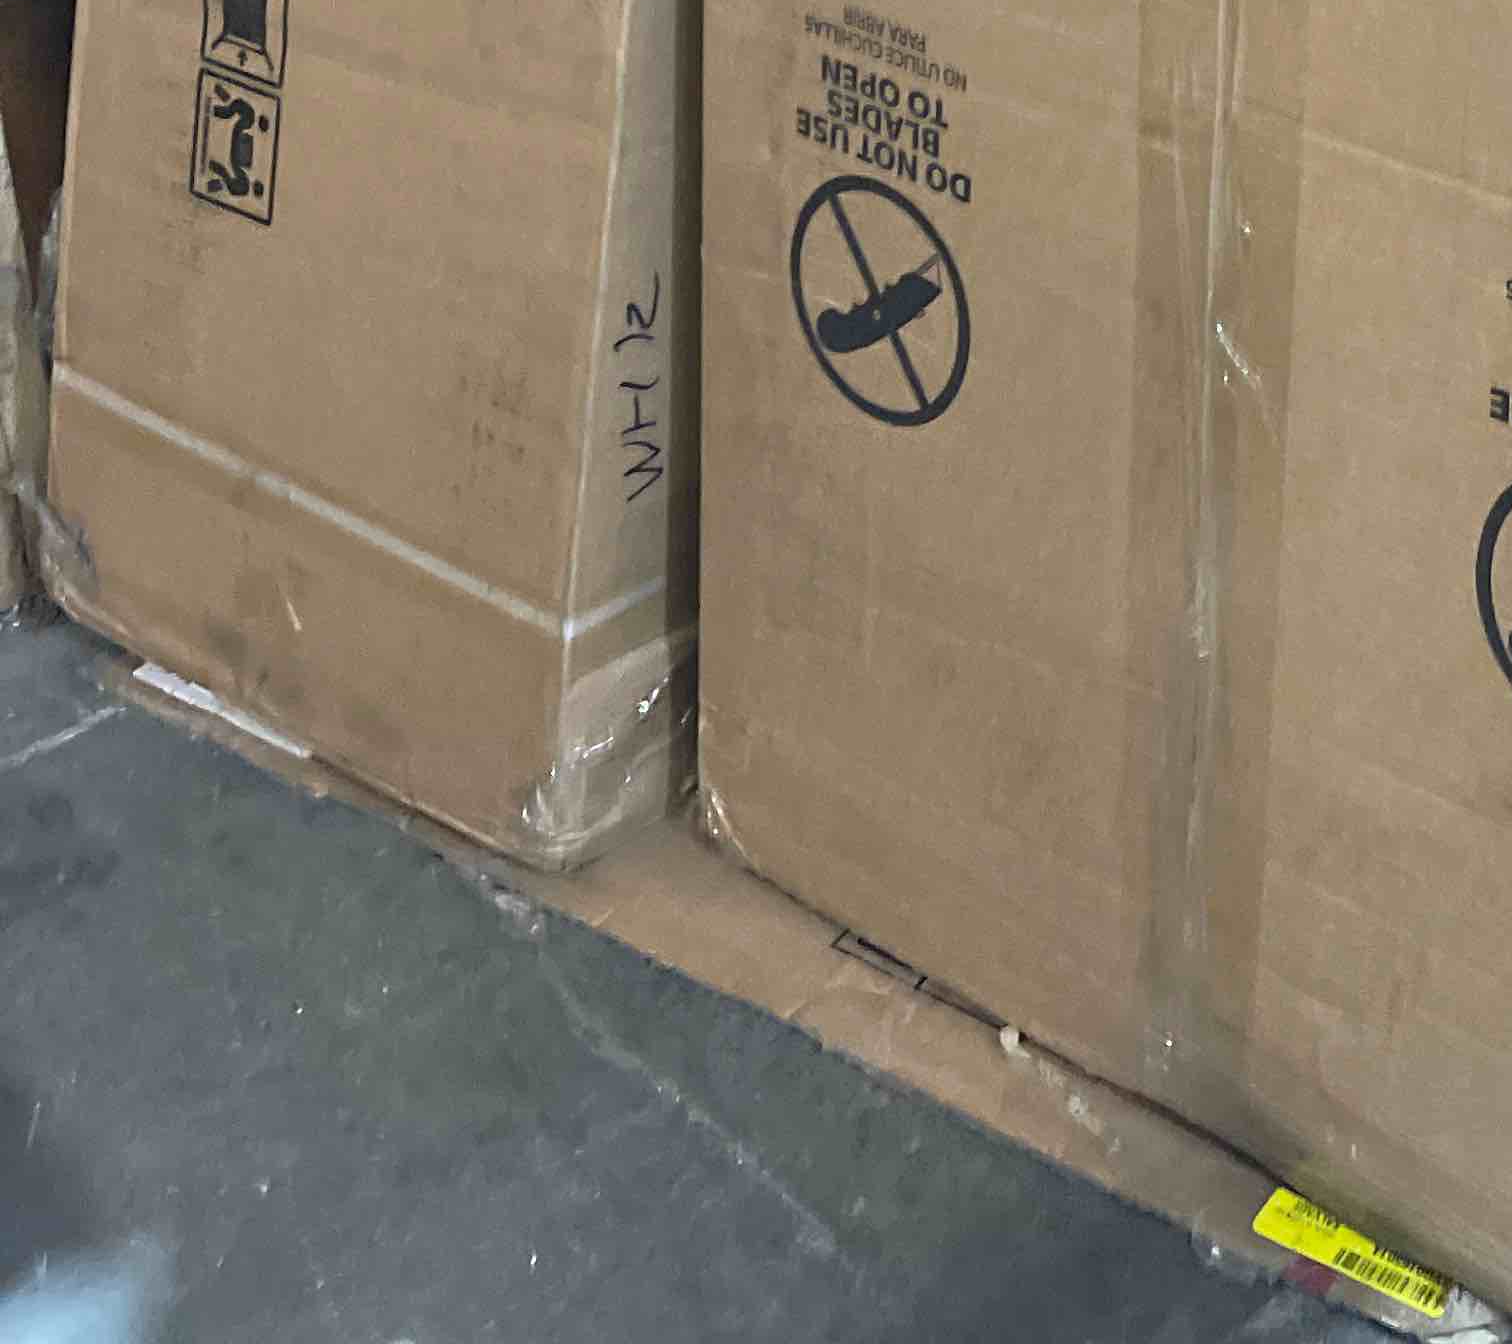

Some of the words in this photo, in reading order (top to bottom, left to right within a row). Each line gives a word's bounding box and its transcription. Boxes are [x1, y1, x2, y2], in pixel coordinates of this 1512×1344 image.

[804, 15, 883, 59] CUCHILLAS
[843, 5, 886, 37] ABRIR
[890, 26, 927, 52] PARA
[821, 54, 900, 107] OPEN
[886, 49, 940, 82] UTILICE
[943, 67, 967, 93] NO
[797, 107, 848, 153] USE
[827, 90, 940, 158] BLADES
[908, 90, 949, 129] TO
[858, 140, 917, 182] NOT
[925, 159, 971, 203] DO
